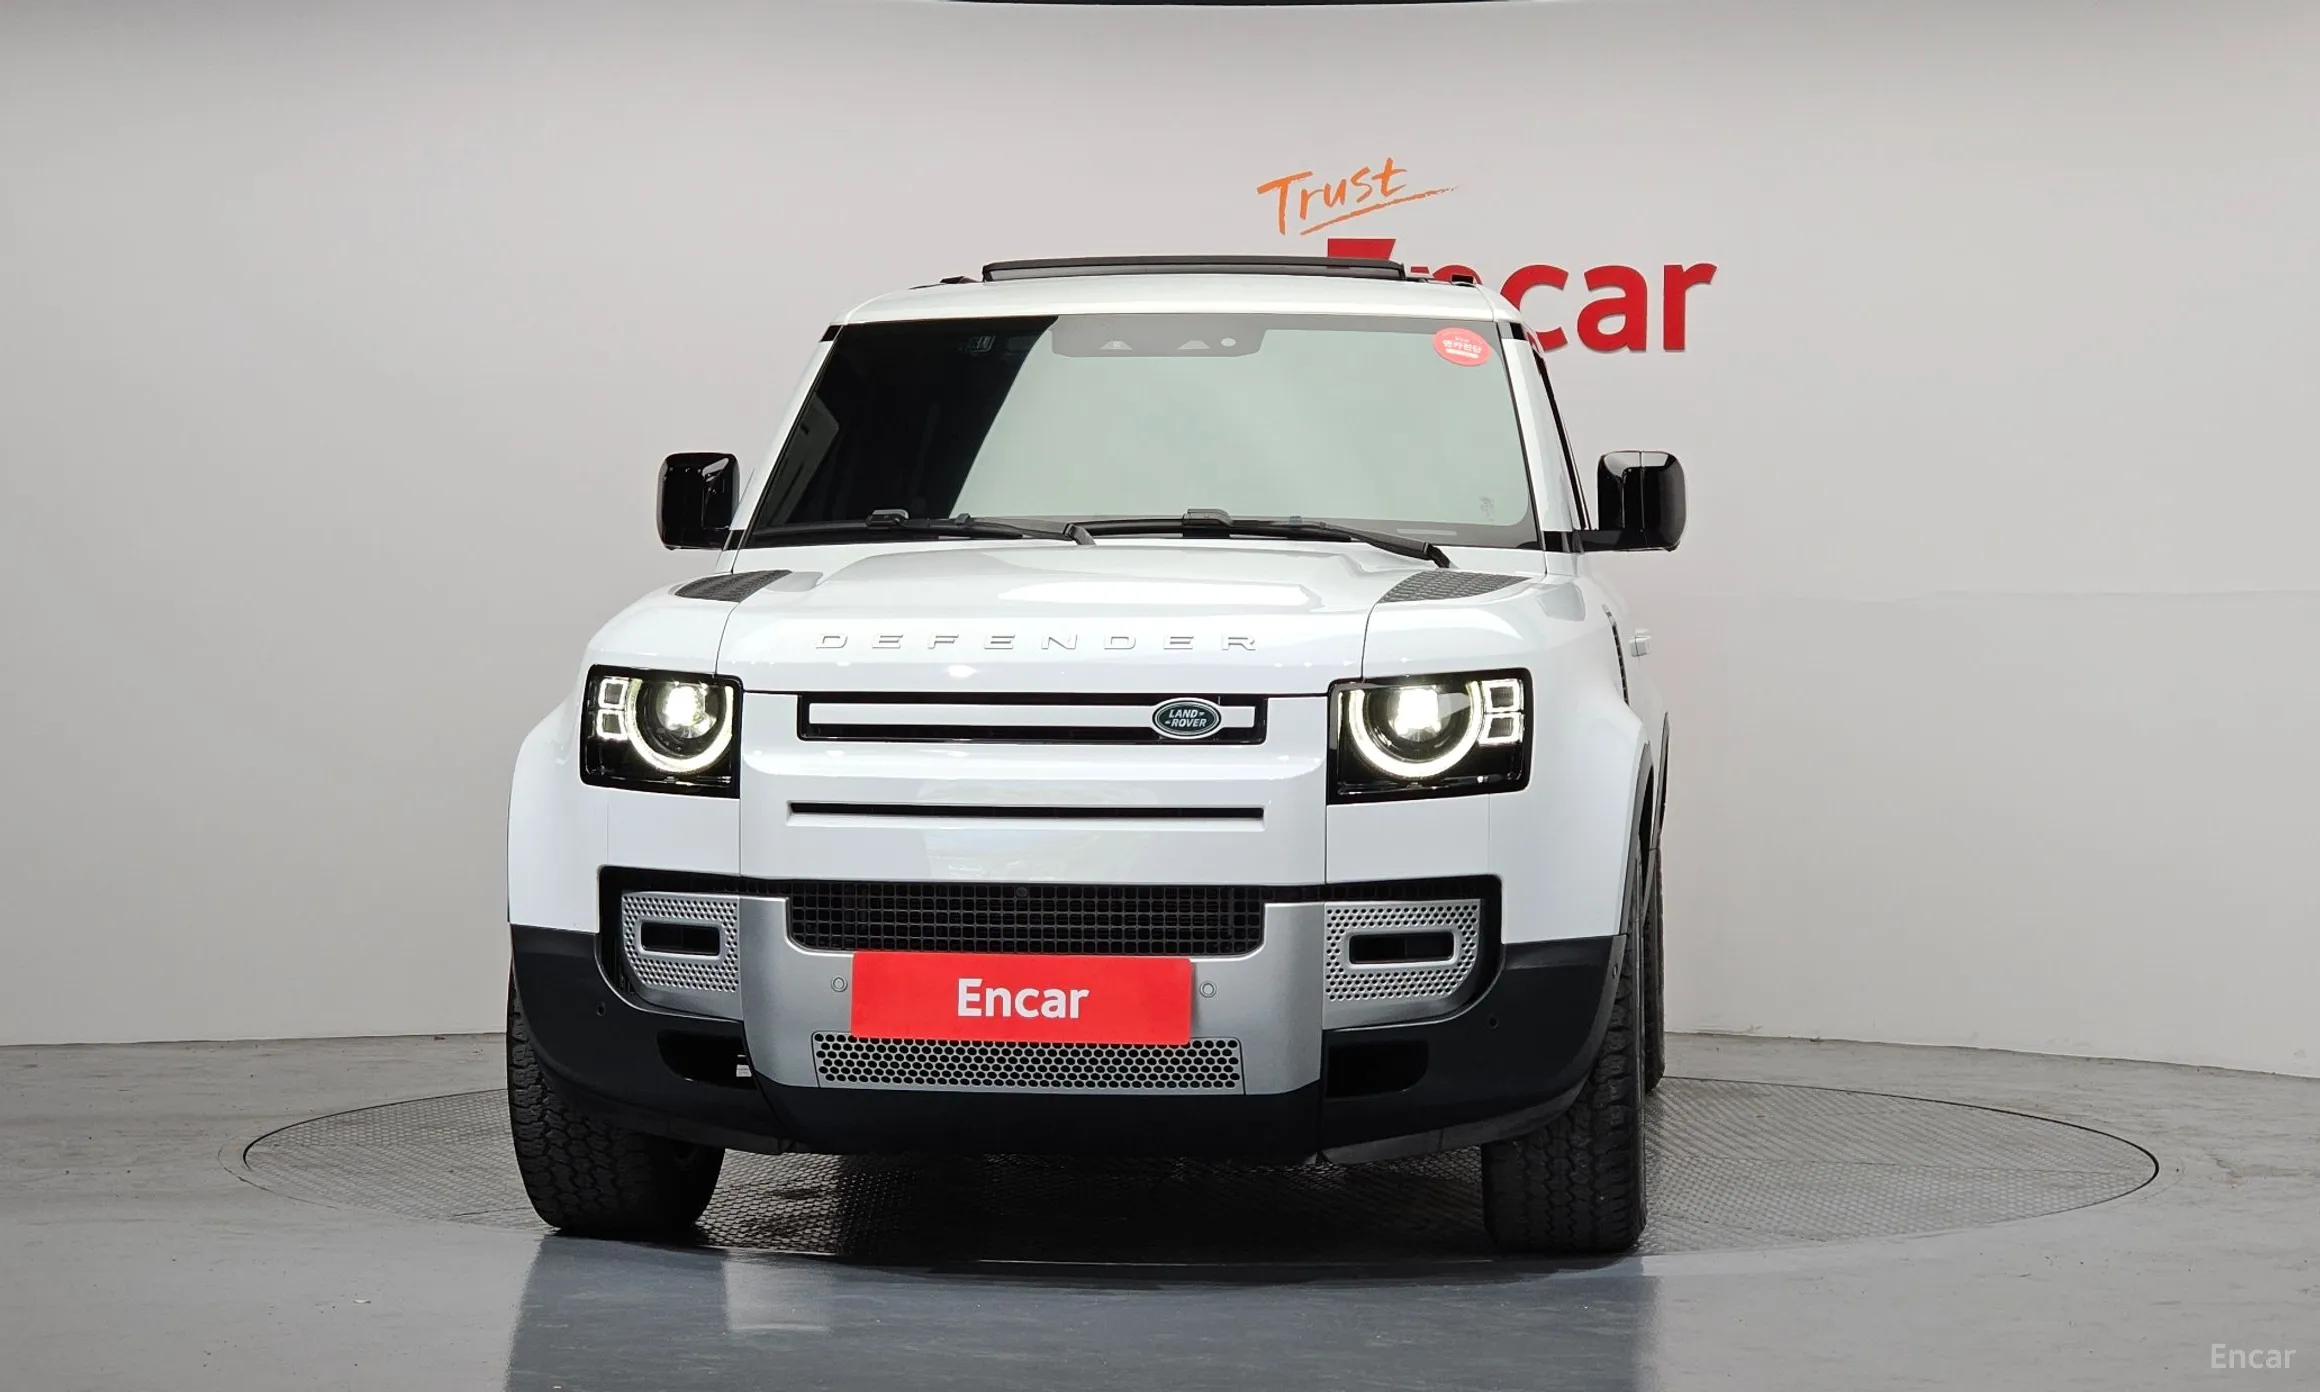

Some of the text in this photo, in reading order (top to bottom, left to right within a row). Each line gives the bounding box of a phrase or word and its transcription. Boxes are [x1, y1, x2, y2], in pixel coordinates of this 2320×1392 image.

[1257, 157, 1408, 235] Trust
[1327, 238, 1717, 352] car
[815, 633, 1256, 651] DEFENDER
[957, 978, 1090, 1019] Encar
